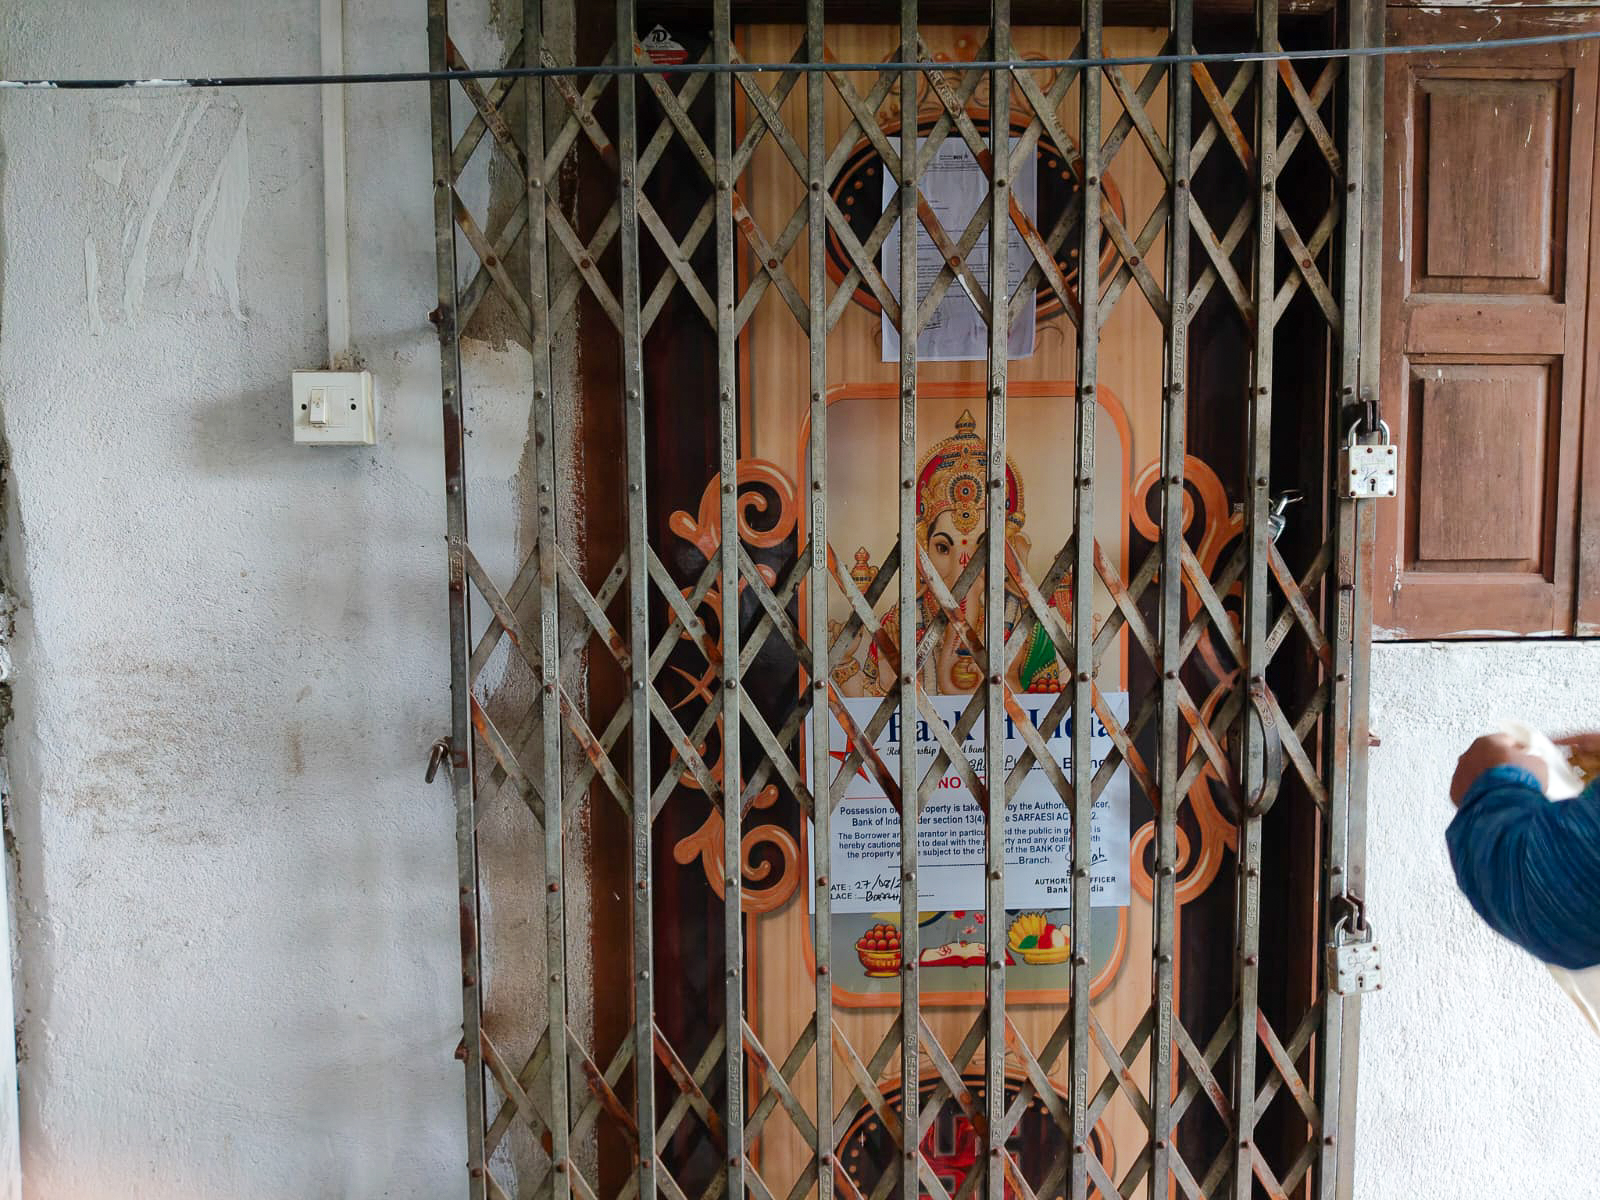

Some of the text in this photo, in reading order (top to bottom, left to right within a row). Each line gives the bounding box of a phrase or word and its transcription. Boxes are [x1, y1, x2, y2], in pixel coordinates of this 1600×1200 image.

[840, 807, 887, 815] Possession
[954, 804, 960, 812] is
[963, 803, 981, 812] take
[1020, 802, 1032, 810] the
[852, 818, 873, 826] Bank
[876, 817, 883, 825] of
[933, 816, 963, 824] section
[1012, 812, 1054, 822] SARFAESI
[839, 832, 852, 840] The
[855, 832, 890, 840] Borrower
[1029, 827, 1052, 836] public
[839, 841, 865, 850] hereby
[867, 841, 900, 849] cautione
[968, 838, 980, 846] the
[862, 851, 894, 860] property
[922, 848, 951, 856] subject
[1047, 886, 1068, 894] Bank
